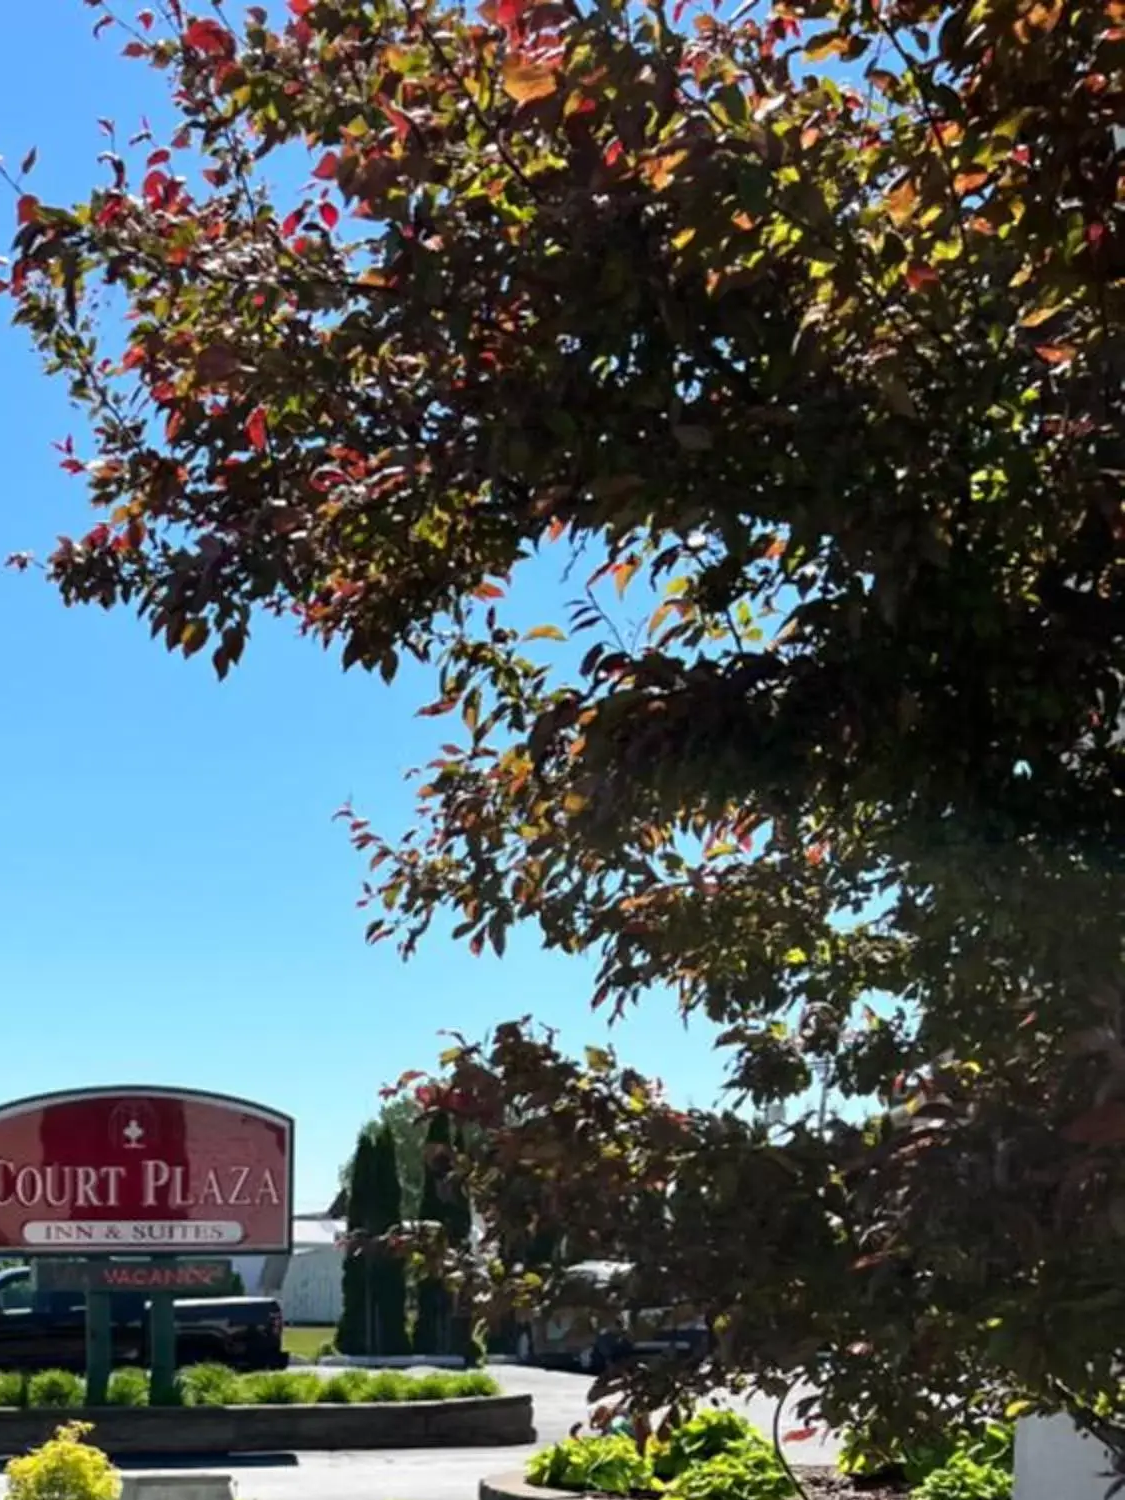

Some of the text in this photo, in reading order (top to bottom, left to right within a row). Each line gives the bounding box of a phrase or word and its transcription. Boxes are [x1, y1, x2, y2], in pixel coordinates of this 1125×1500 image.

[142, 1160, 281, 1207] PLAZA
[44, 1223, 224, 1240] INN & SUITES
